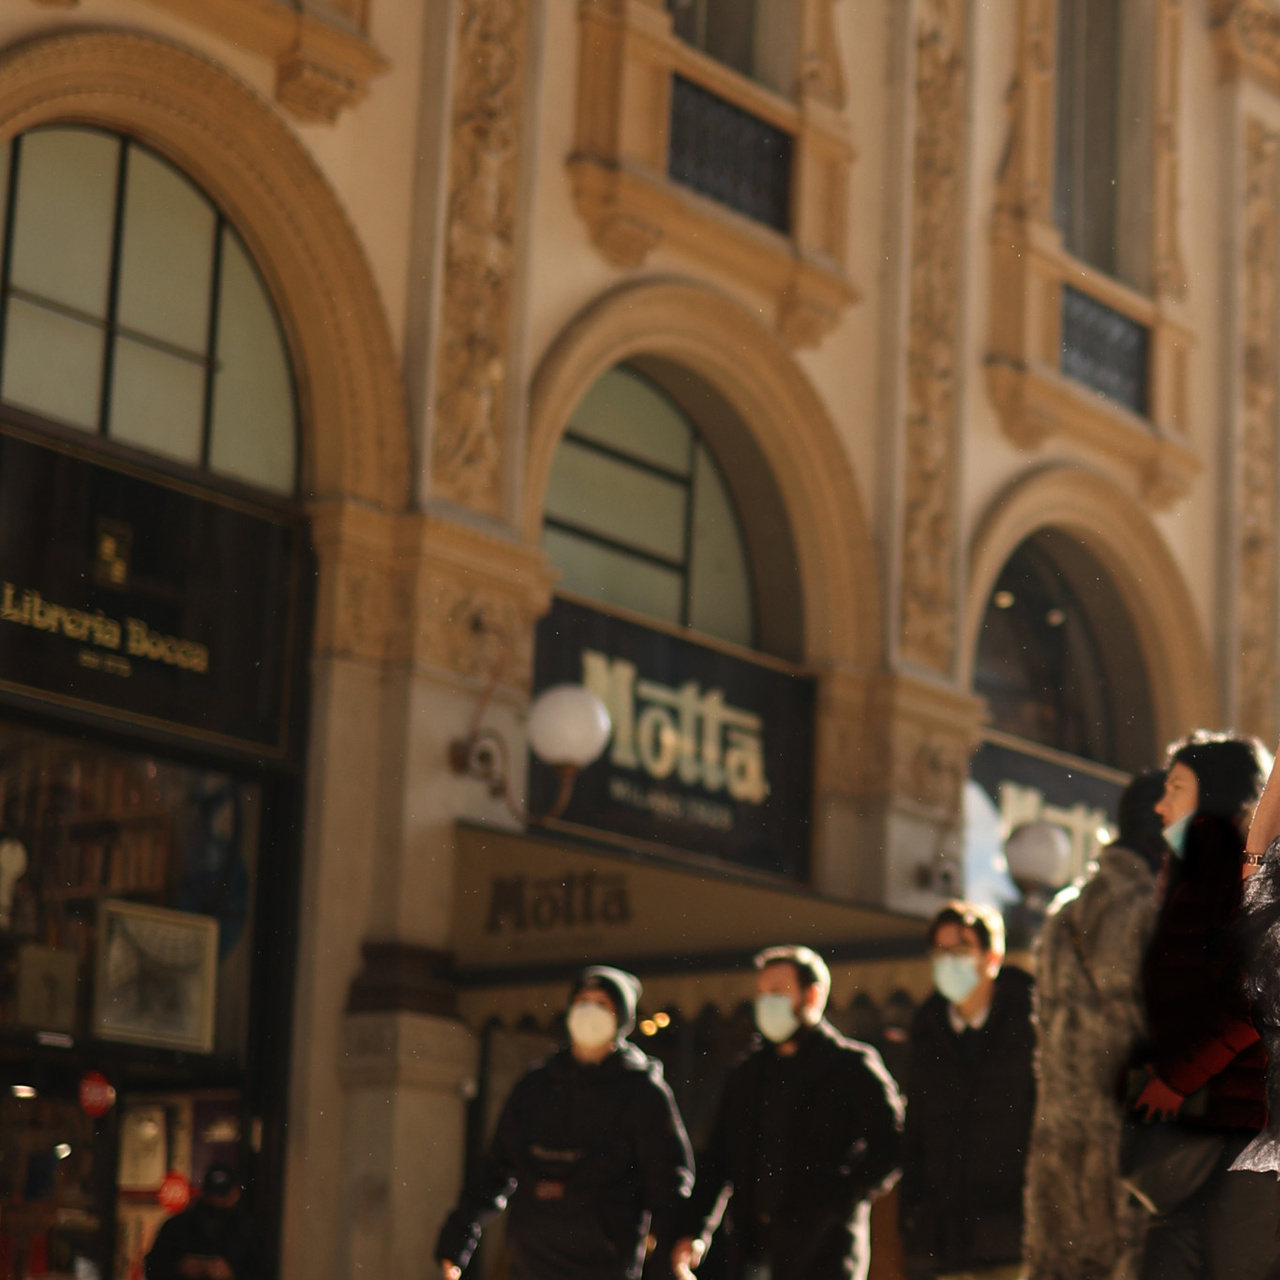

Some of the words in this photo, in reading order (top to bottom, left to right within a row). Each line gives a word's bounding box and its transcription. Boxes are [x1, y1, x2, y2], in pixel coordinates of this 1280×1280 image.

[1, 581, 121, 650] Libreria
[127, 618, 208, 673] Bocca
[582, 648, 771, 805] Motta
[487, 870, 632, 932] Motta
